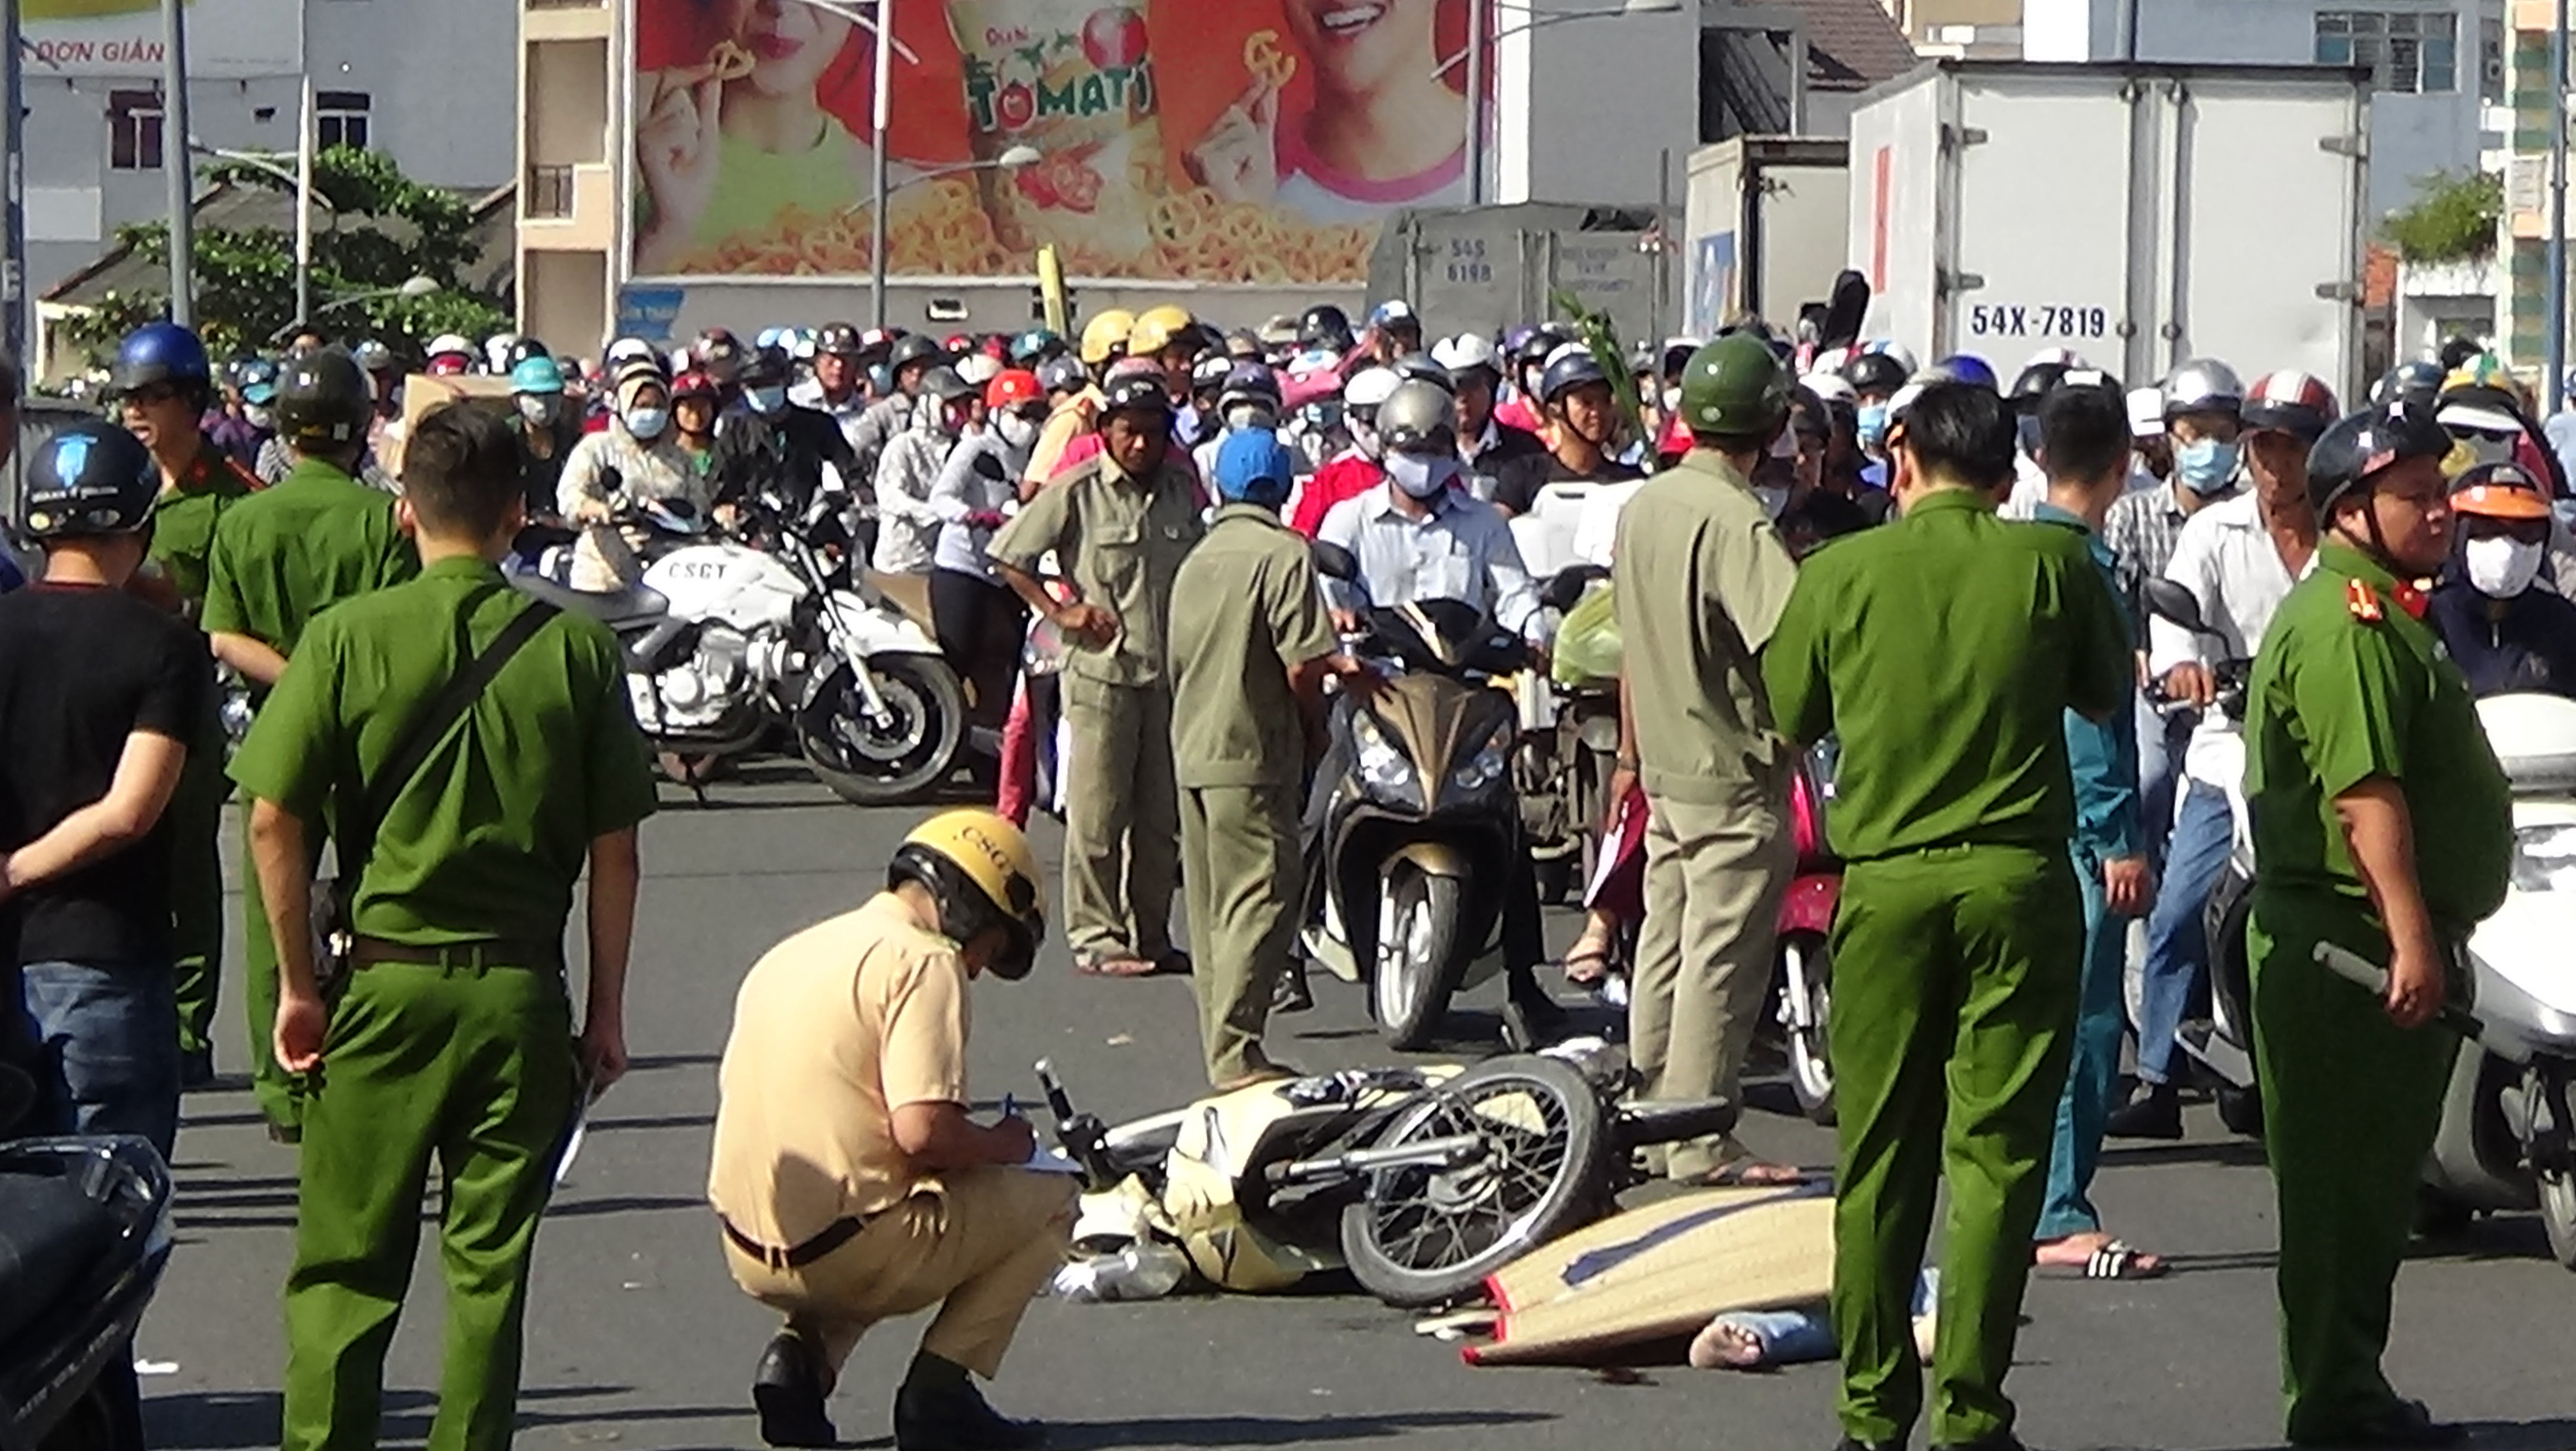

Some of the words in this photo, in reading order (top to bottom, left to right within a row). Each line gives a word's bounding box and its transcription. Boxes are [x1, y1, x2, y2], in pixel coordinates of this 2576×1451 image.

[1972, 305, 2105, 338] 54X-7819
[668, 561, 727, 579] CSGT
[962, 826, 1013, 873] CSG
